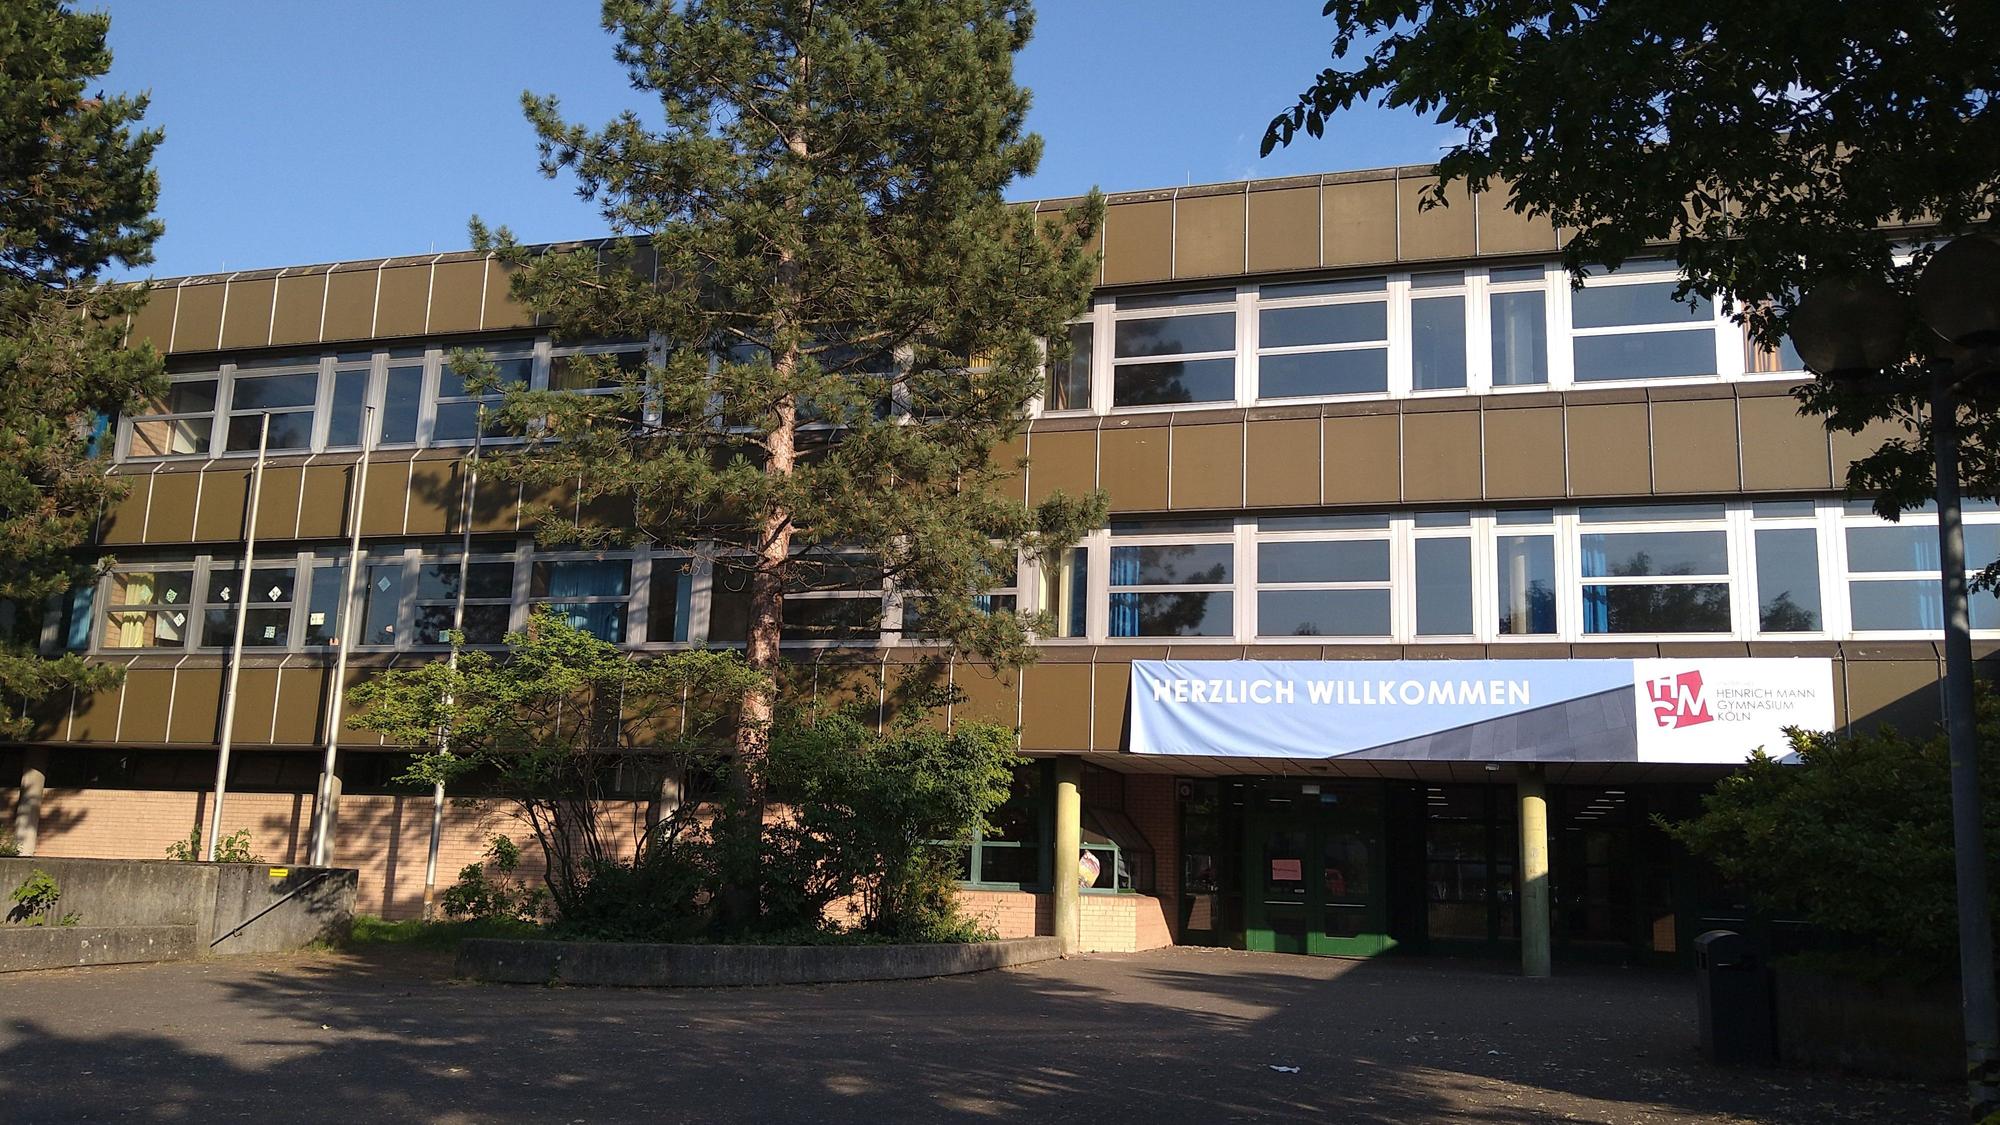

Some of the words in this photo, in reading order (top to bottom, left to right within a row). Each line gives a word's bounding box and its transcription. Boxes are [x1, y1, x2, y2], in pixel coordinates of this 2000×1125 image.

[1153, 679, 1294, 704] HERZLICH
[1307, 680, 1530, 705] WILLKOMMEN
[1716, 688, 1773, 699] HEINRICH
[1777, 688, 1816, 699] MANN
[1717, 700, 1794, 710] GYMNASIUM
